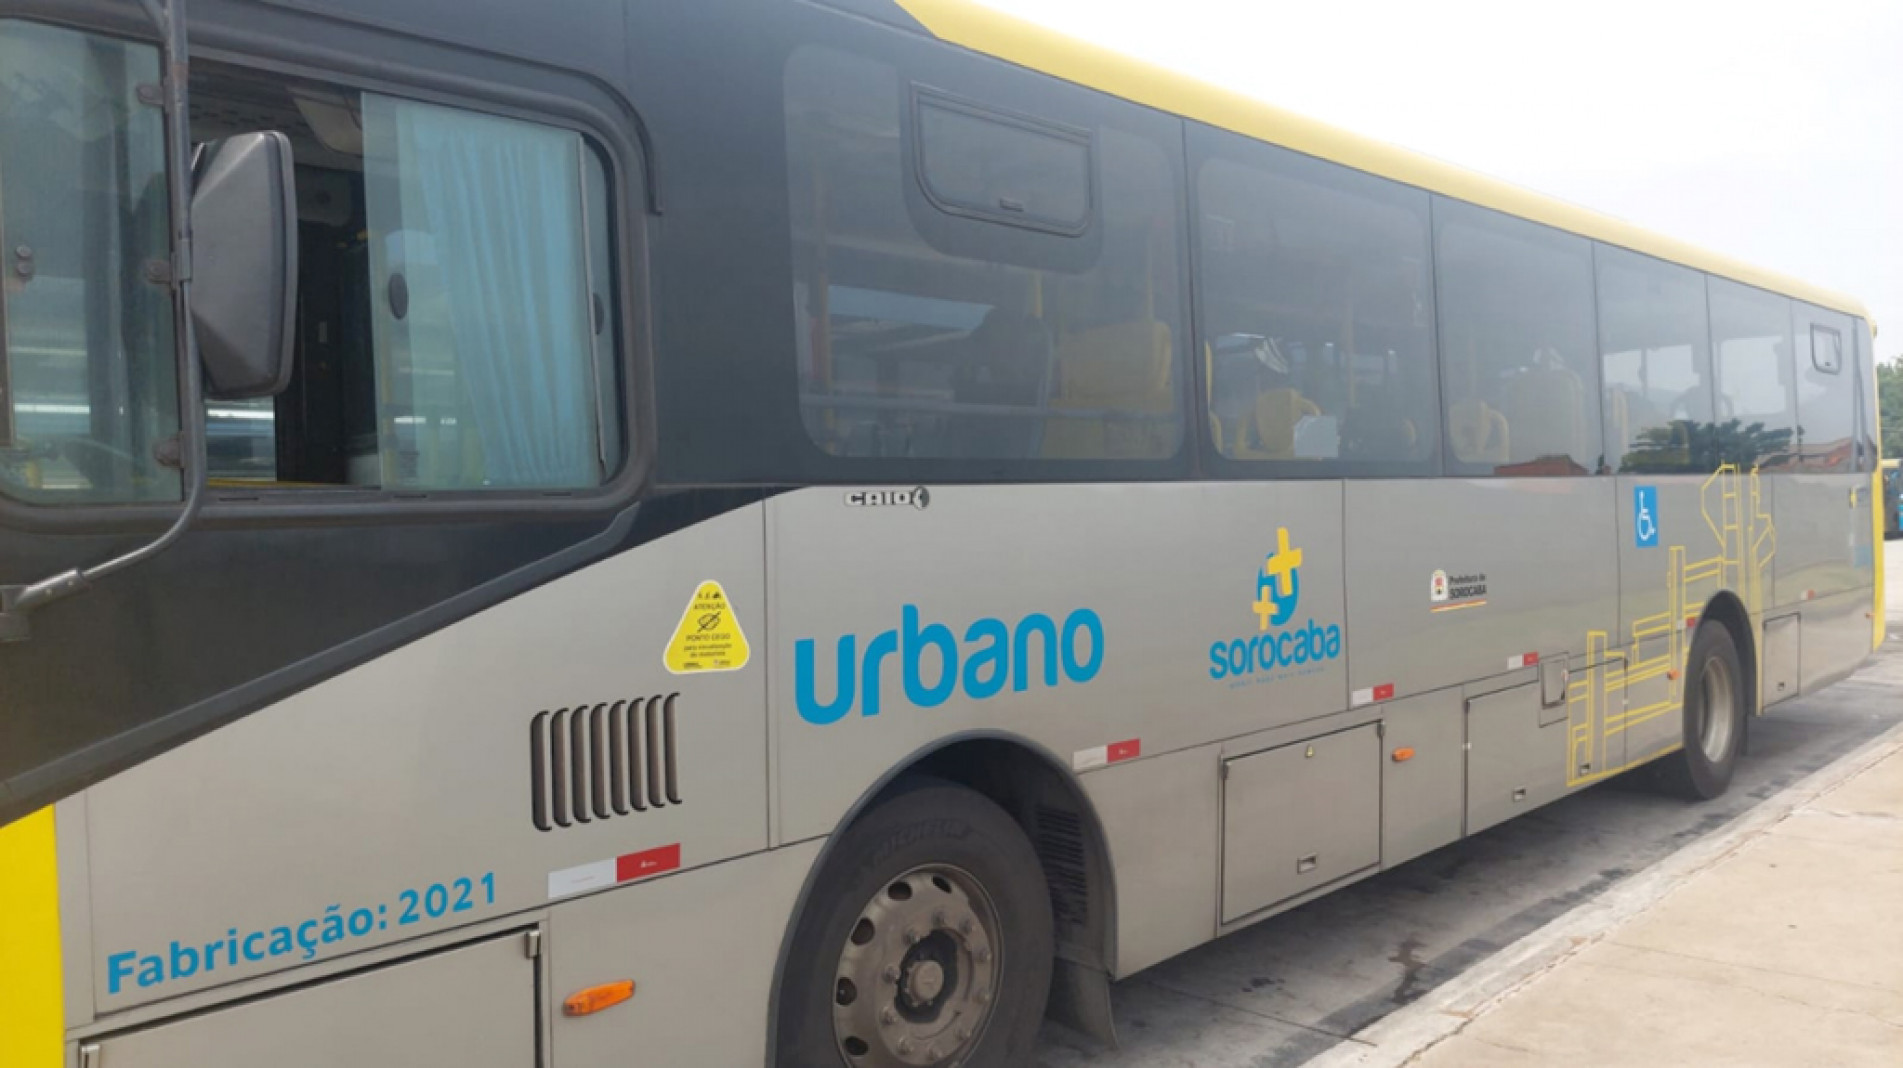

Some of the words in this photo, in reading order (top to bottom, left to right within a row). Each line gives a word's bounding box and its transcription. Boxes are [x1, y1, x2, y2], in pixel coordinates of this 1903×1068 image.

[1449, 584, 1487, 600] SOROCABA
[795, 604, 1104, 725] urbano
[1209, 618, 1340, 680] sorocaba
[108, 904, 387, 994] Fabricação:
[399, 872, 494, 925] 2021
